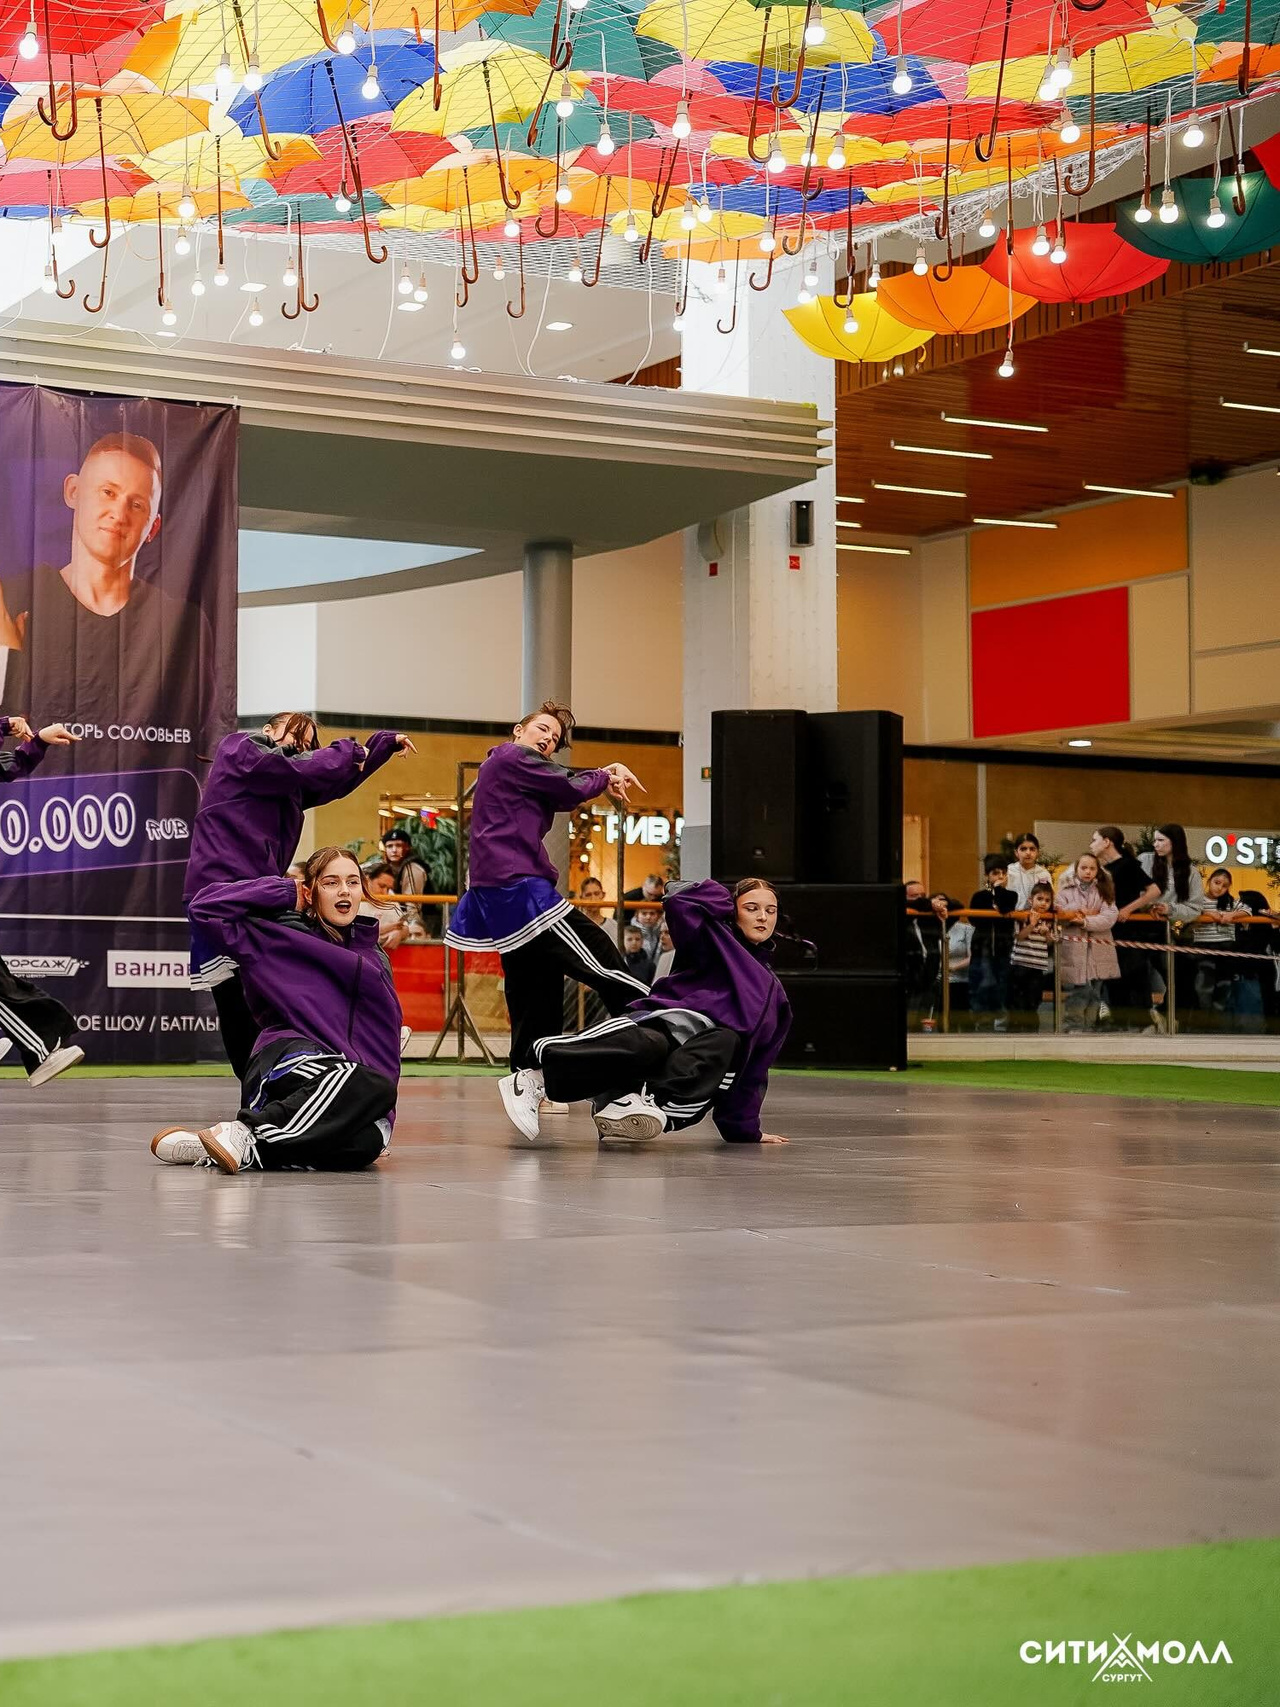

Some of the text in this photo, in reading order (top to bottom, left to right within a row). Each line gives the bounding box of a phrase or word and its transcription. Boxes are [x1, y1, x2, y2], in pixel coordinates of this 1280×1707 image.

[51, 722, 192, 744] ГОРЬ СОЛОВЬЕВ
[145, 818, 190, 841] RUB
[1205, 832, 1280, 865] O'ST
[114, 962, 190, 977] ванла
[104, 1014, 145, 1032] ШОУ
[160, 1015, 221, 1032] БАТТЛЫ
